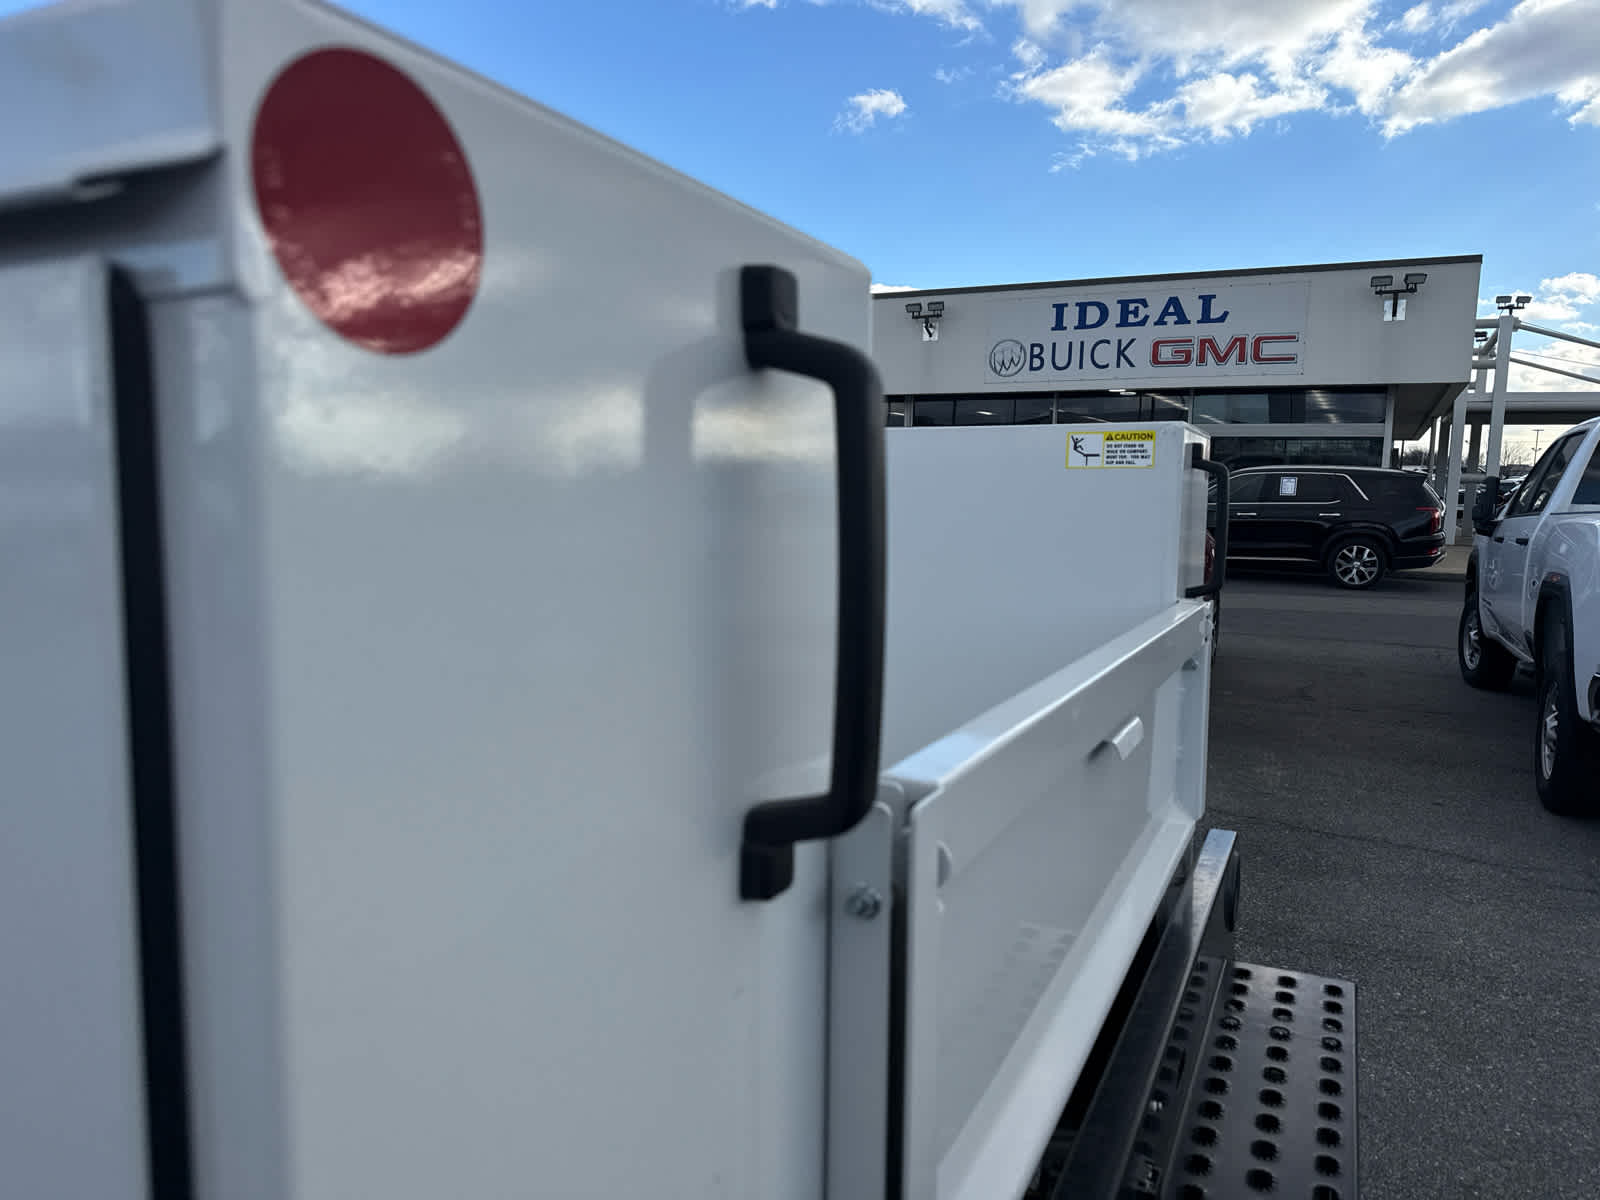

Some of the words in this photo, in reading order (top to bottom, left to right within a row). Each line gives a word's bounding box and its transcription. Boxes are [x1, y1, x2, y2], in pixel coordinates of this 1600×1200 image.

[1050, 294, 1230, 331] IDEAL
[1029, 338, 1137, 372] BUICK
[1150, 332, 1299, 368] GMC
[1114, 432, 1153, 441] CAUTION
